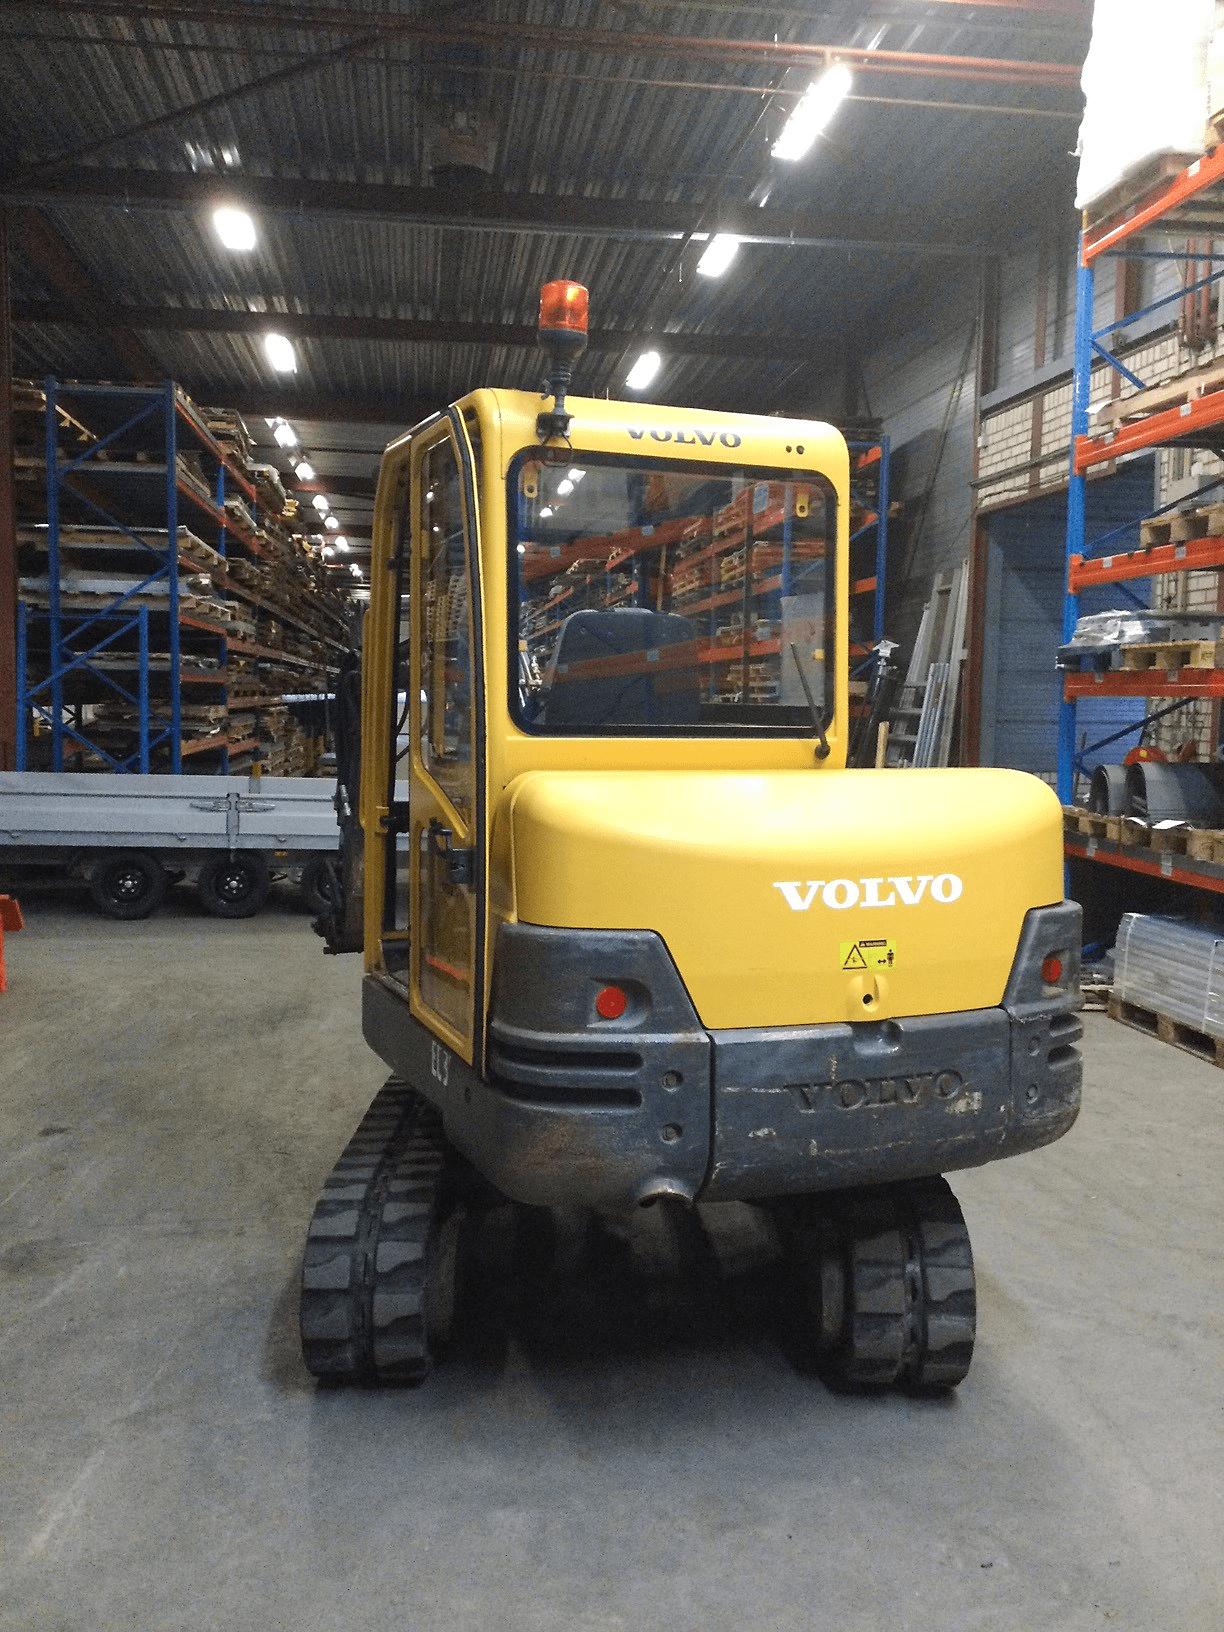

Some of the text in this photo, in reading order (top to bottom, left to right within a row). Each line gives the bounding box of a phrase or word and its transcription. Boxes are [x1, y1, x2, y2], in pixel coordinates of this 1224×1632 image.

[627, 428, 741, 448] VOLVO
[773, 874, 963, 911] VOLVO
[783, 1069, 963, 1113] VOLVO
